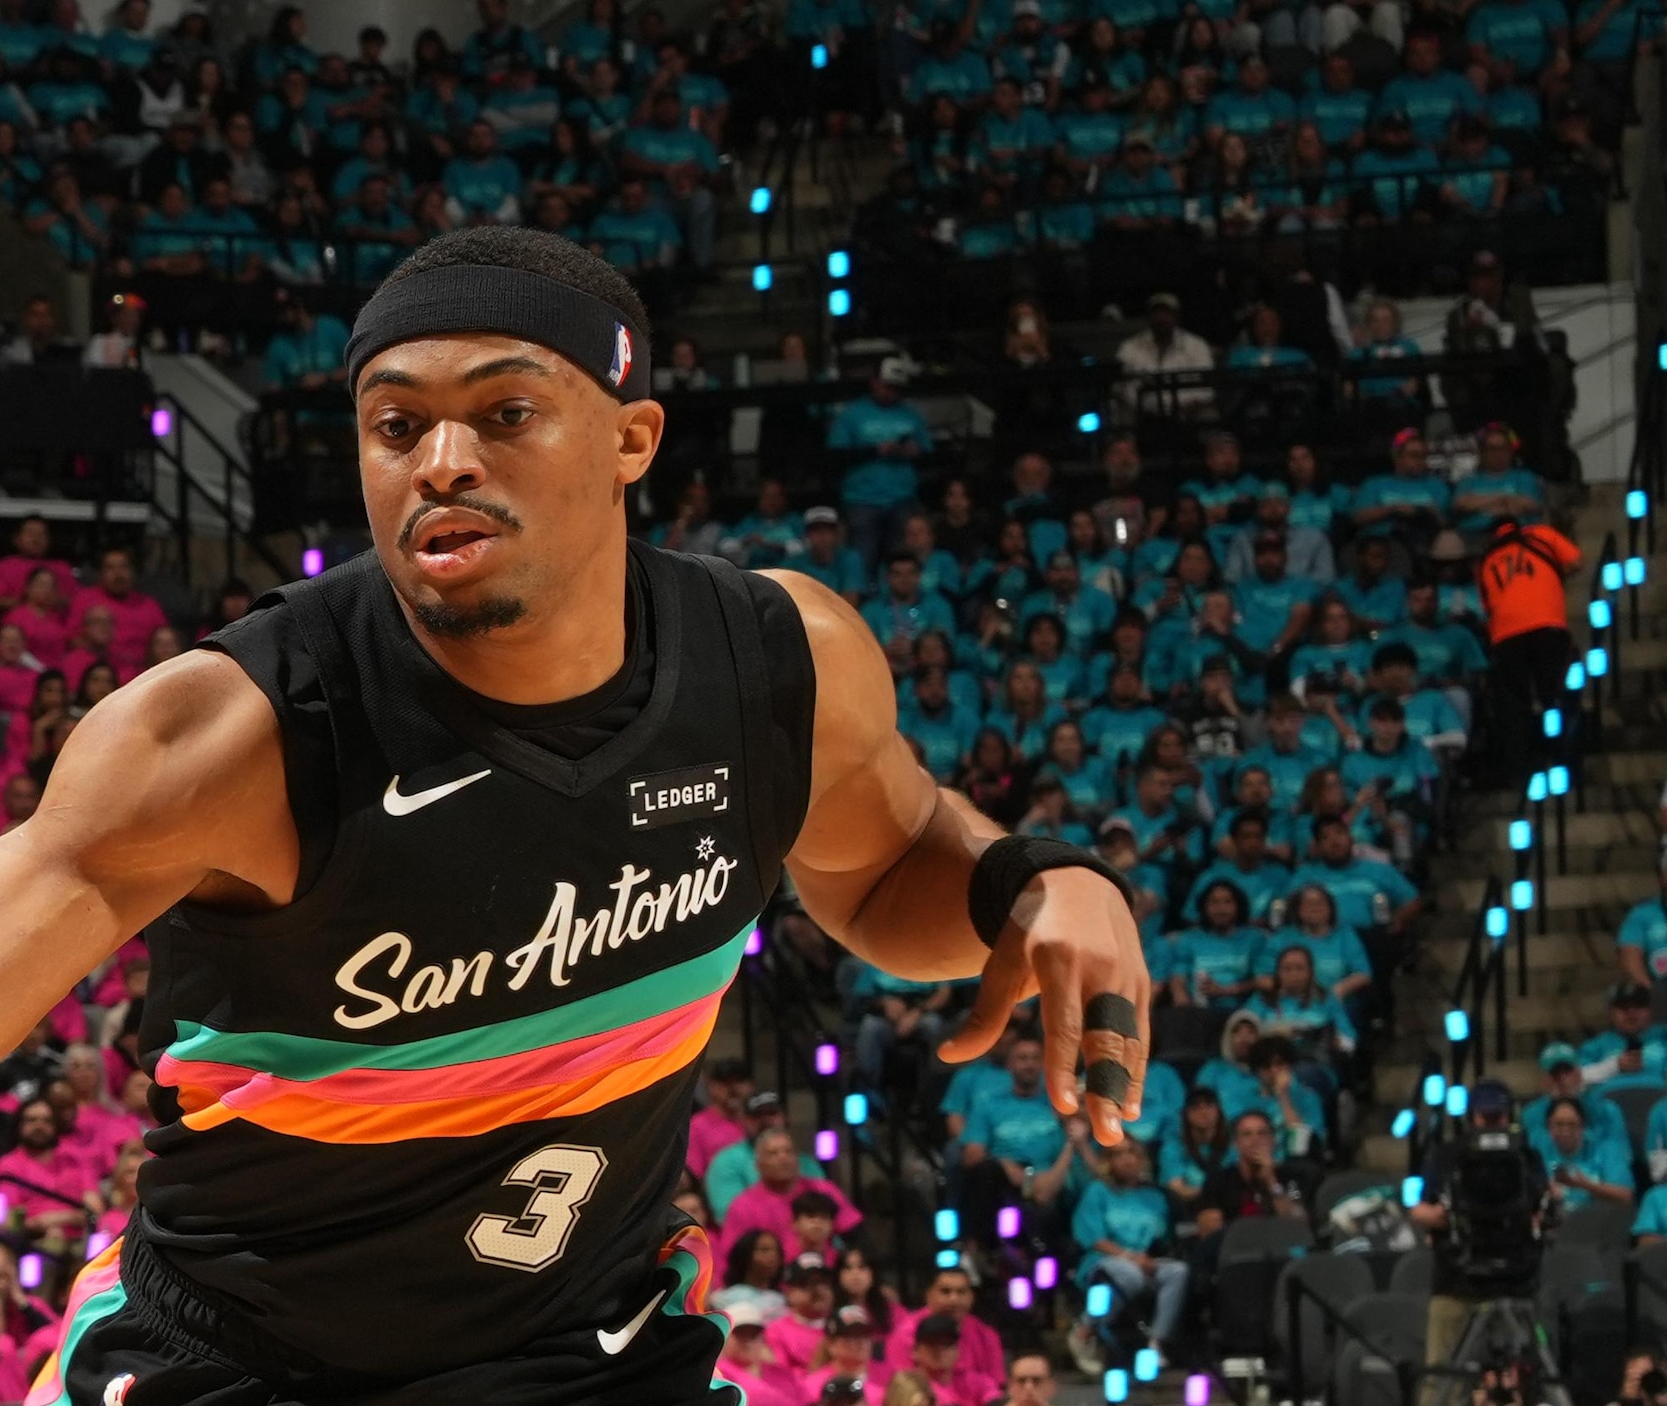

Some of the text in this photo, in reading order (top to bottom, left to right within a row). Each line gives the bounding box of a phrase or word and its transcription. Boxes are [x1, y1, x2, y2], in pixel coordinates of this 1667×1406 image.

[644, 782, 717, 811] LEDGER
[333, 840, 738, 1030] San Antonio
[464, 1143, 609, 1274] 3
